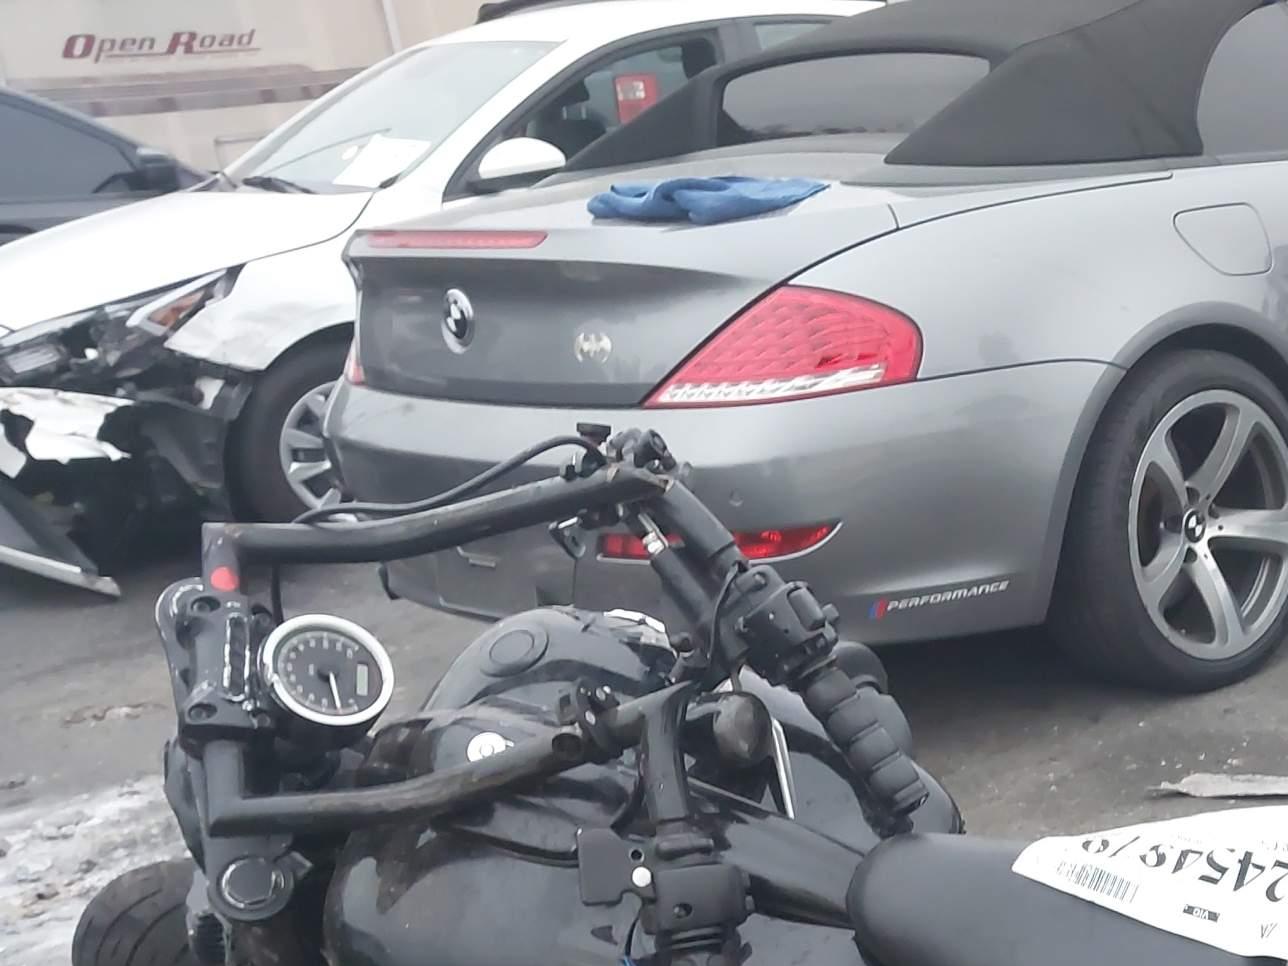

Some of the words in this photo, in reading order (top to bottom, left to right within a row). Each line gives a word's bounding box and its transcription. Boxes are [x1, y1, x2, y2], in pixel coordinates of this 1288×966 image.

[62, 34, 156, 63] Open
[166, 29, 256, 55] Road
[887, 580, 1010, 611] PERFORMANCE
